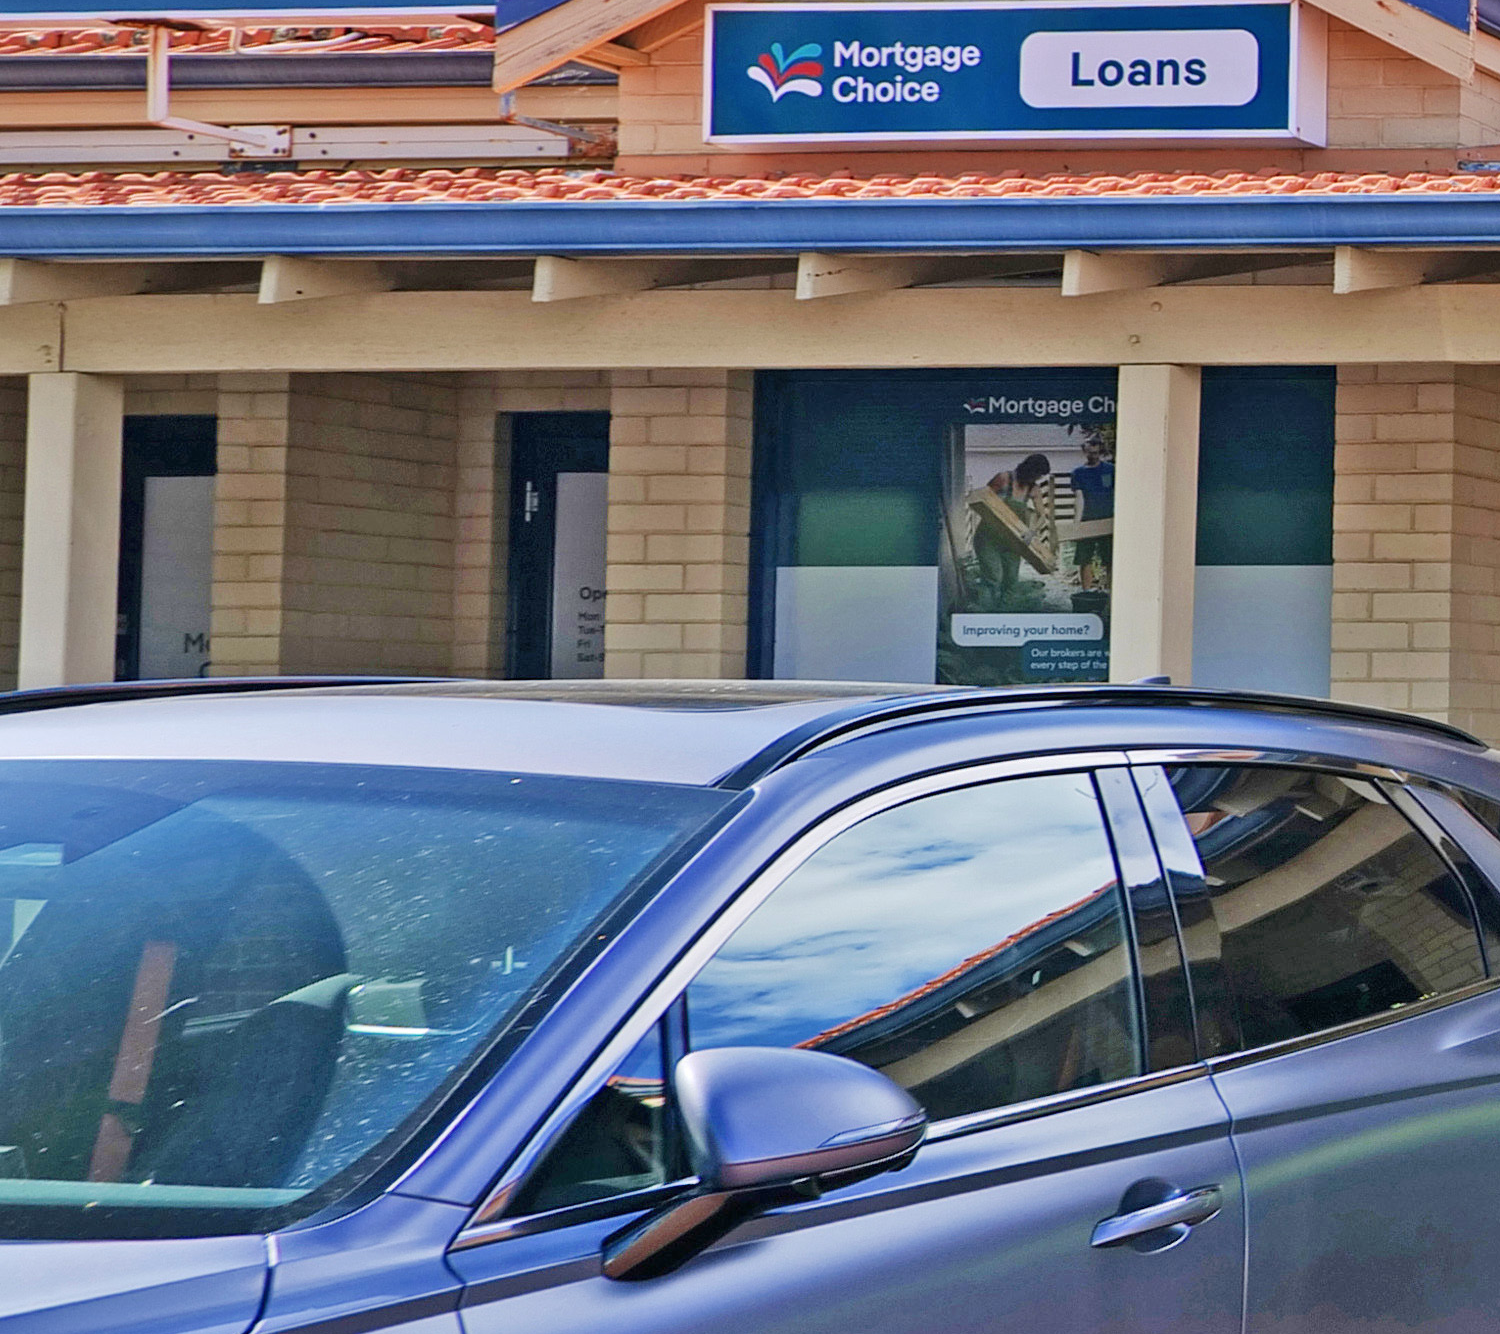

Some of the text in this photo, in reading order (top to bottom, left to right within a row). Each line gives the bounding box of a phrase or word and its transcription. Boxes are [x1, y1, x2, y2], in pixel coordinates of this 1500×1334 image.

[833, 41, 981, 72] Mortgage
[1070, 52, 1208, 87] Loans
[832, 76, 940, 103] Choice
[989, 396, 1084, 417] Mortgage
[963, 624, 1090, 637] Improving your home?
[1031, 648, 1048, 657] Our
[1051, 648, 1085, 657] brokers
[1031, 661, 1055, 670] every
[1058, 660, 1077, 670] step
[1080, 659, 1090, 669] of
